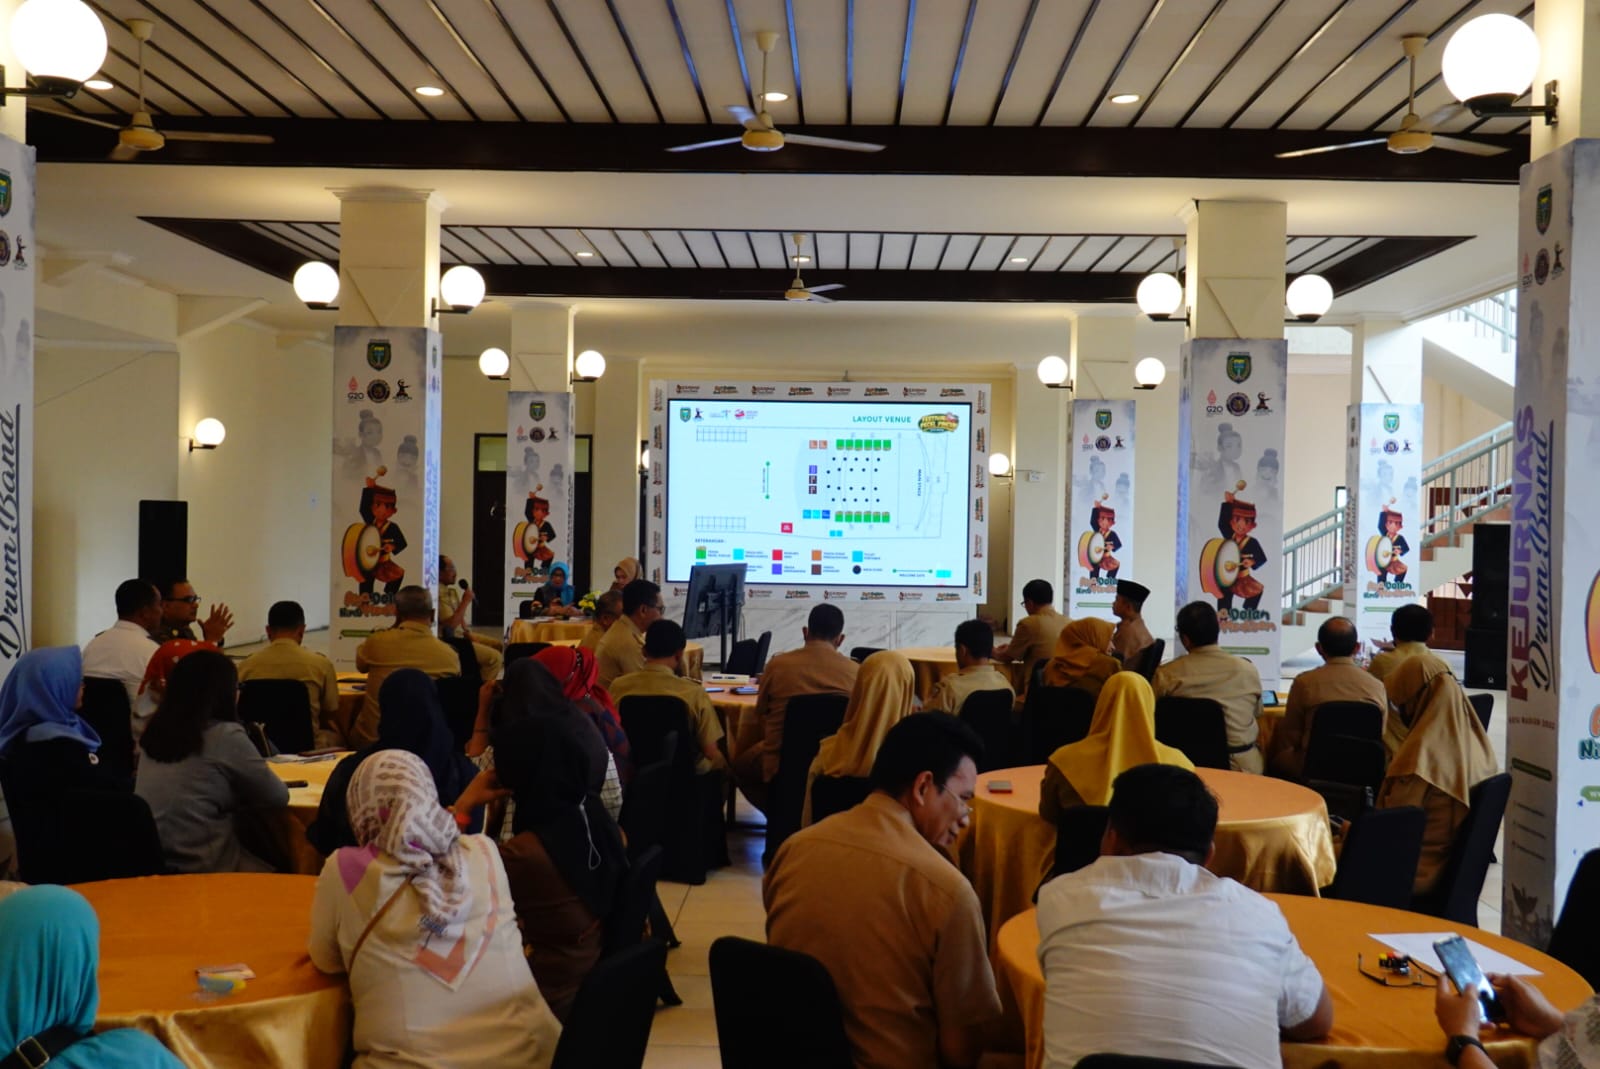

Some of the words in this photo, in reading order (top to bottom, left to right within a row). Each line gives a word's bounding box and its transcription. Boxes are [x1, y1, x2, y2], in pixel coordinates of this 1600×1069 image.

[884, 416, 912, 424] VENUE
[1206, 405, 1224, 413] G20
[0, 410, 18, 533] Band
[1526, 430, 1550, 558] Band
[0, 537, 21, 659] Drum
[1230, 607, 1270, 621] Dolan
[1384, 581, 1412, 591] Dolan
[1509, 406, 1535, 702] KEJURNAS
[1527, 565, 1550, 693] Drum
